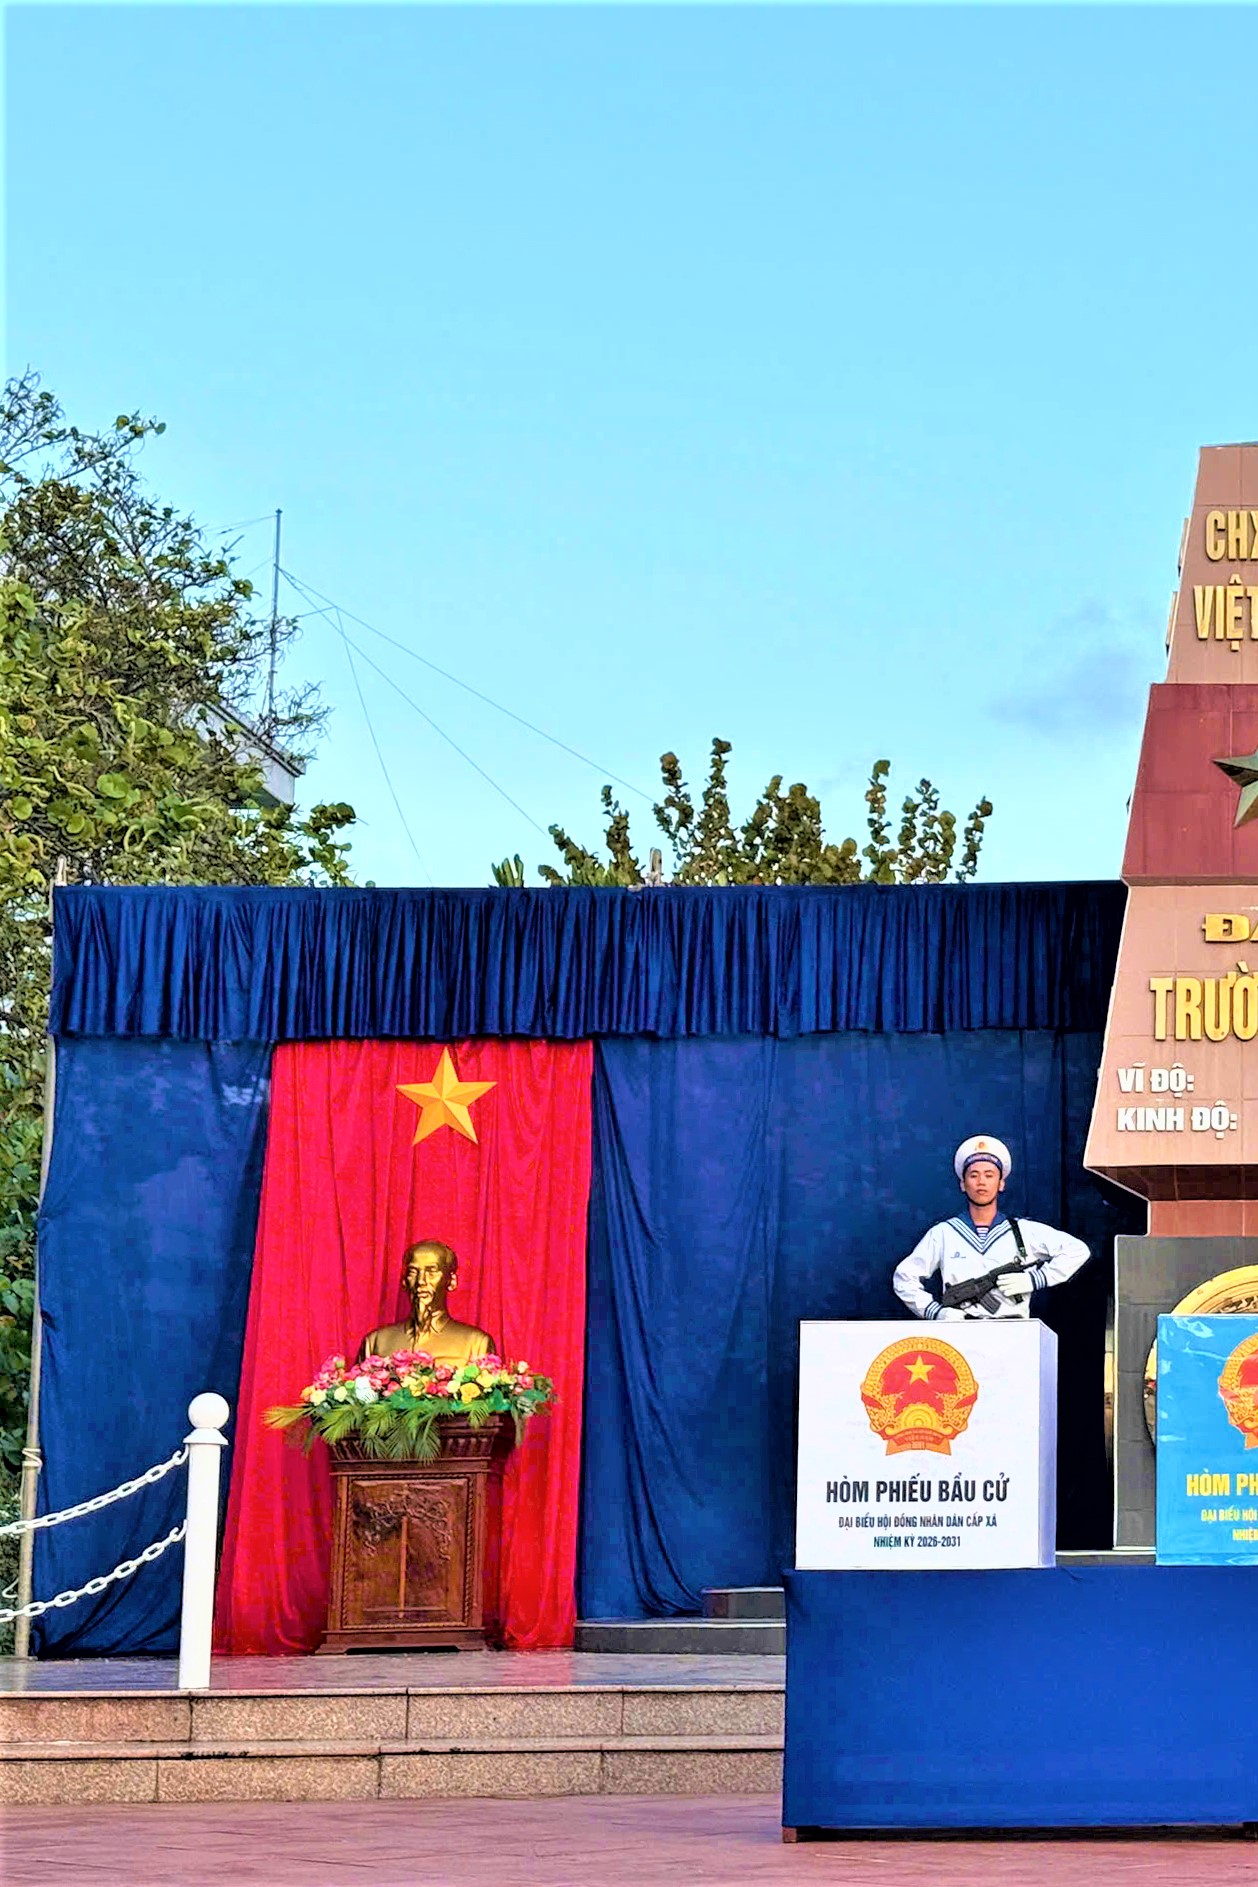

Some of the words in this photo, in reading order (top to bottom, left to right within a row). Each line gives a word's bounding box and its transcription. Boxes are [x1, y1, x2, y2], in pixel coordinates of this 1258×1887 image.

[1117, 1062, 1146, 1093] VĨ
[1149, 1062, 1195, 1099] ĐỘ:
[1116, 1106, 1185, 1133] KINH
[1190, 1100, 1238, 1140] ĐỘ:
[826, 1475, 869, 1503] HÒM
[875, 1472, 932, 1503] PHIẾU
[982, 1472, 1010, 1502] CỬ
[1186, 1468, 1231, 1497] HÒM
[917, 1535, 961, 1548] 2026-2031
